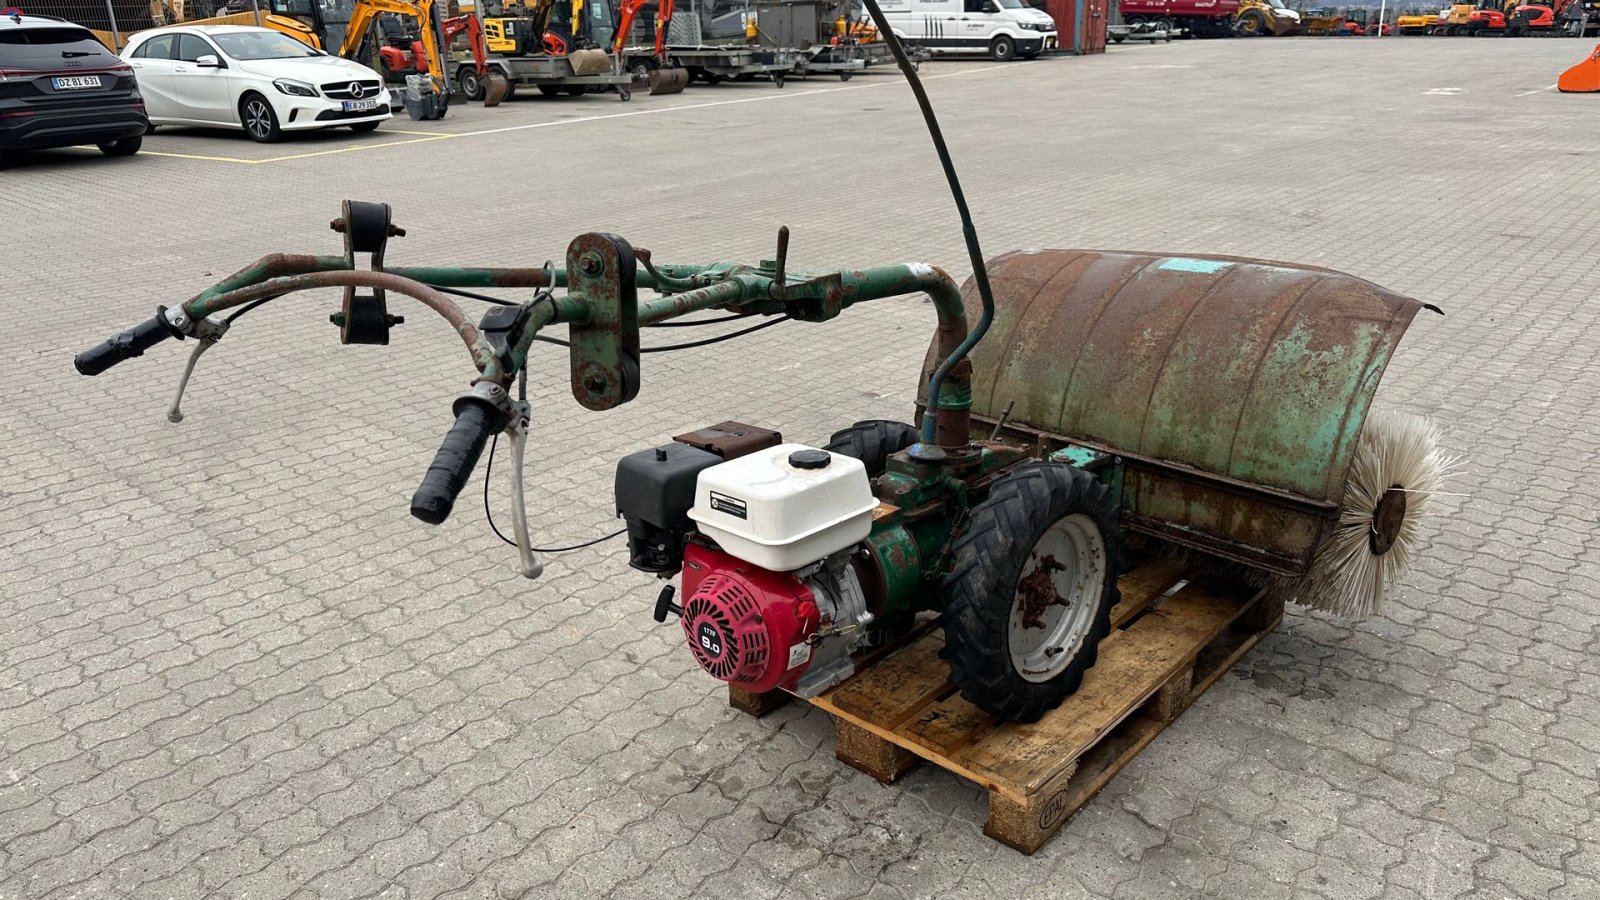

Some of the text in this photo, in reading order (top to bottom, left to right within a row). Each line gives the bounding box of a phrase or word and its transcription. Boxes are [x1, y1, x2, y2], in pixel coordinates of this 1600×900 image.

[59, 77, 99, 87] DZ 81 631
[703, 627, 716, 637] 177F
[701, 635, 720, 654] 9.0
[1044, 795, 1065, 825] EPAL
